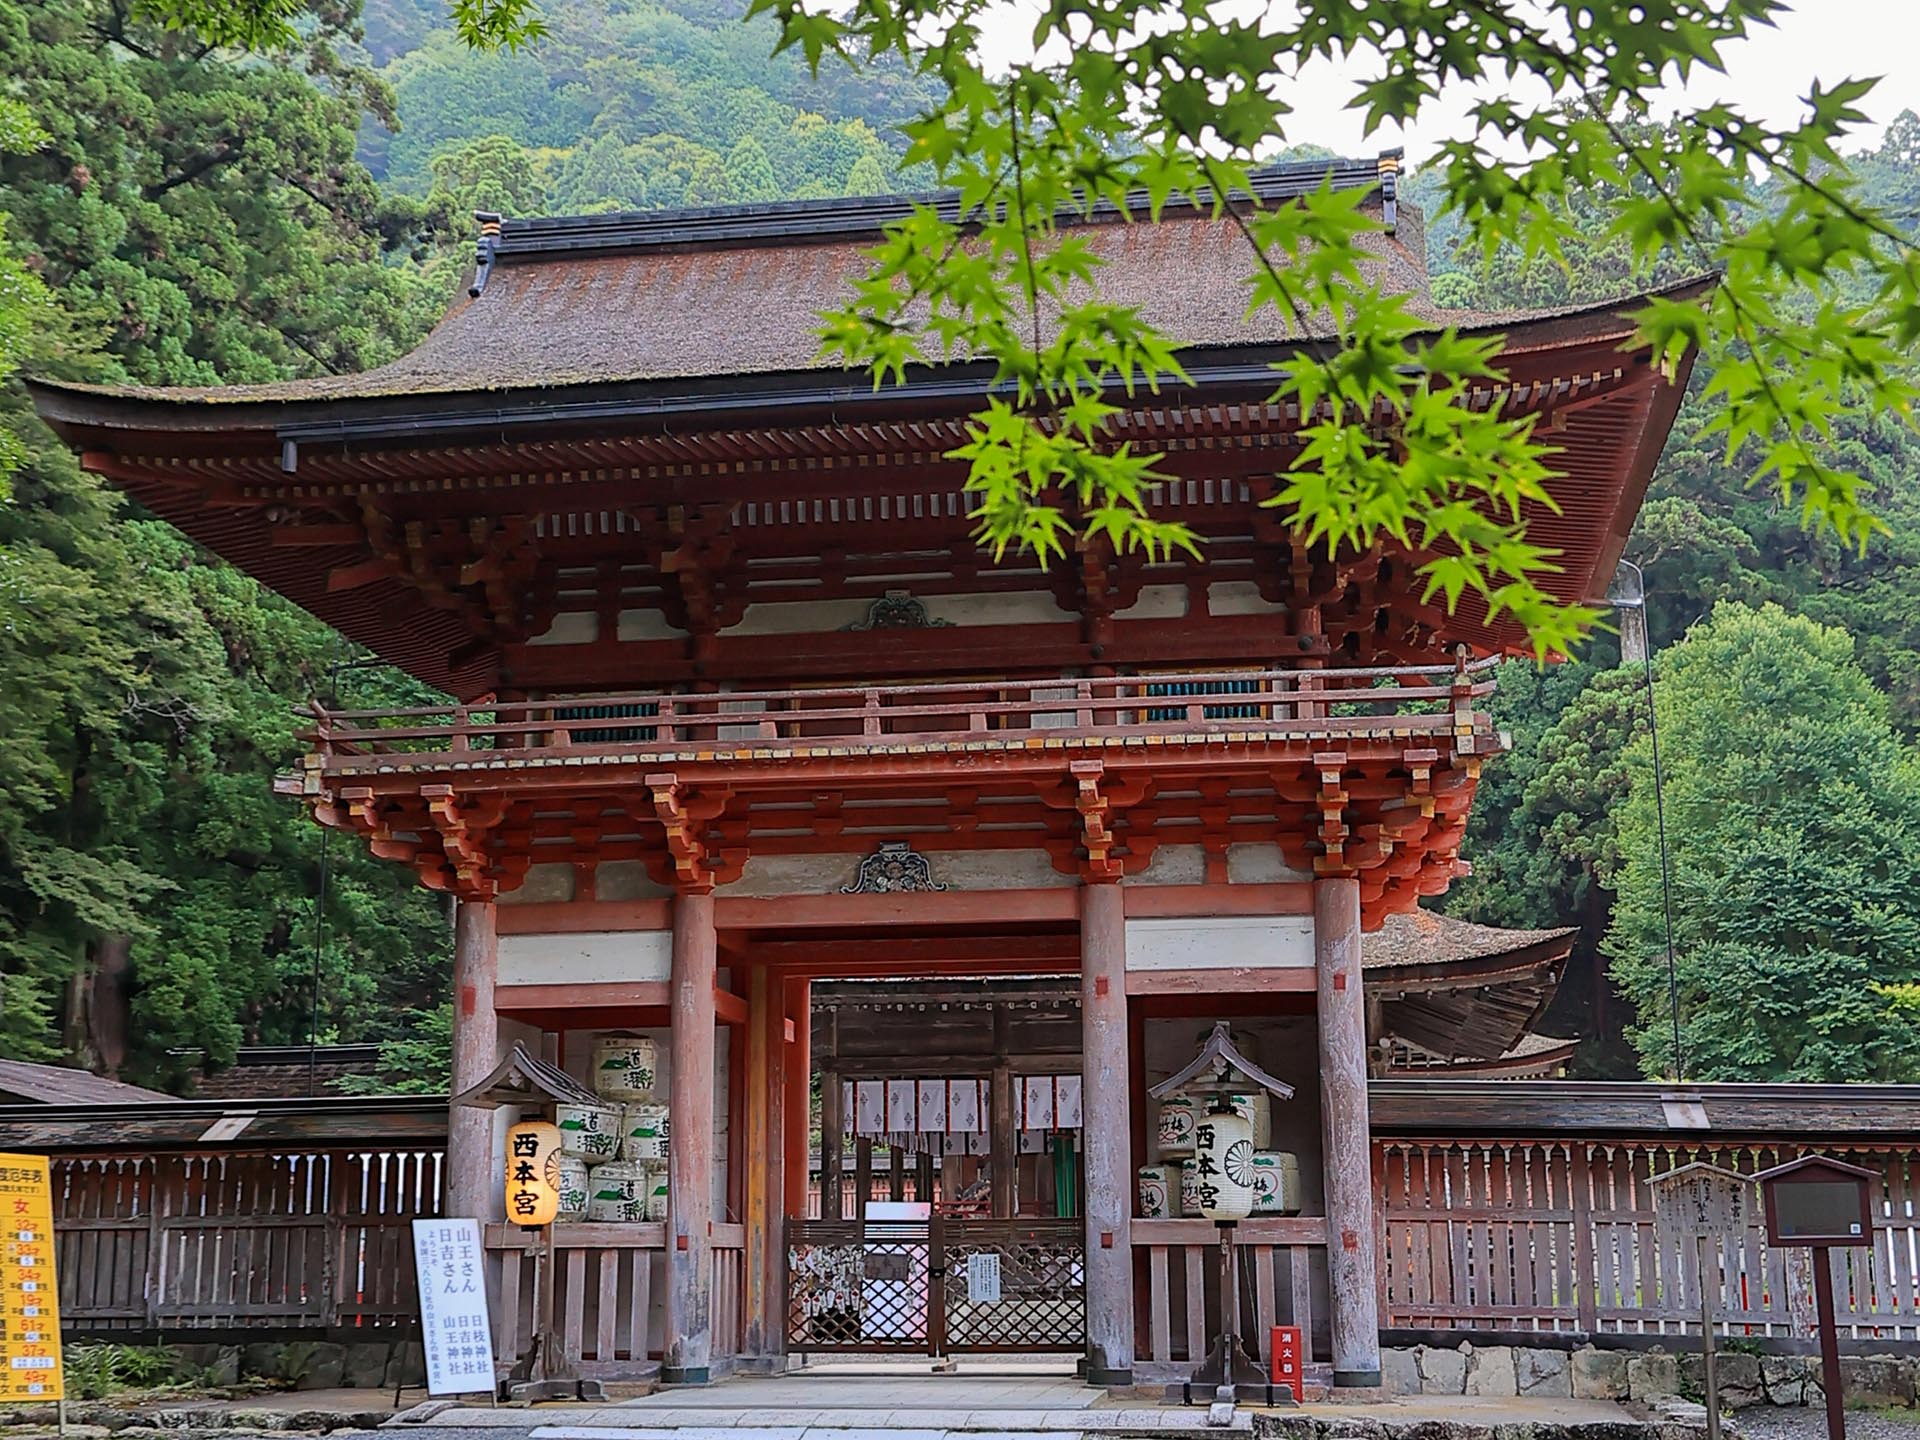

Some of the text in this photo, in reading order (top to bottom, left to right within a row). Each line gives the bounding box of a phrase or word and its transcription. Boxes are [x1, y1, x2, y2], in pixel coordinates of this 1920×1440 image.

[513, 1132, 540, 1216] 西本宮
[1196, 1124, 1220, 1210] 西本宮
[13, 1199, 29, 1214] 女
[15, 1218, 38, 1231] 32才
[17, 1243, 40, 1256] 33才
[428, 1231, 438, 1267] ようこそ
[439, 1228, 458, 1294] 日吉さん
[456, 1227, 476, 1294] 山王さん
[18, 1268, 41, 1281] 34才
[20, 1294, 42, 1306] 19才
[21, 1319, 44, 1331] 61才
[22, 1344, 46, 1356] 37才
[443, 1315, 462, 1375] 山王神社
[458, 1315, 475, 1375] 日吉神社
[471, 1315, 489, 1374] 日枝神社
[24, 1370, 48, 1383] 49才
